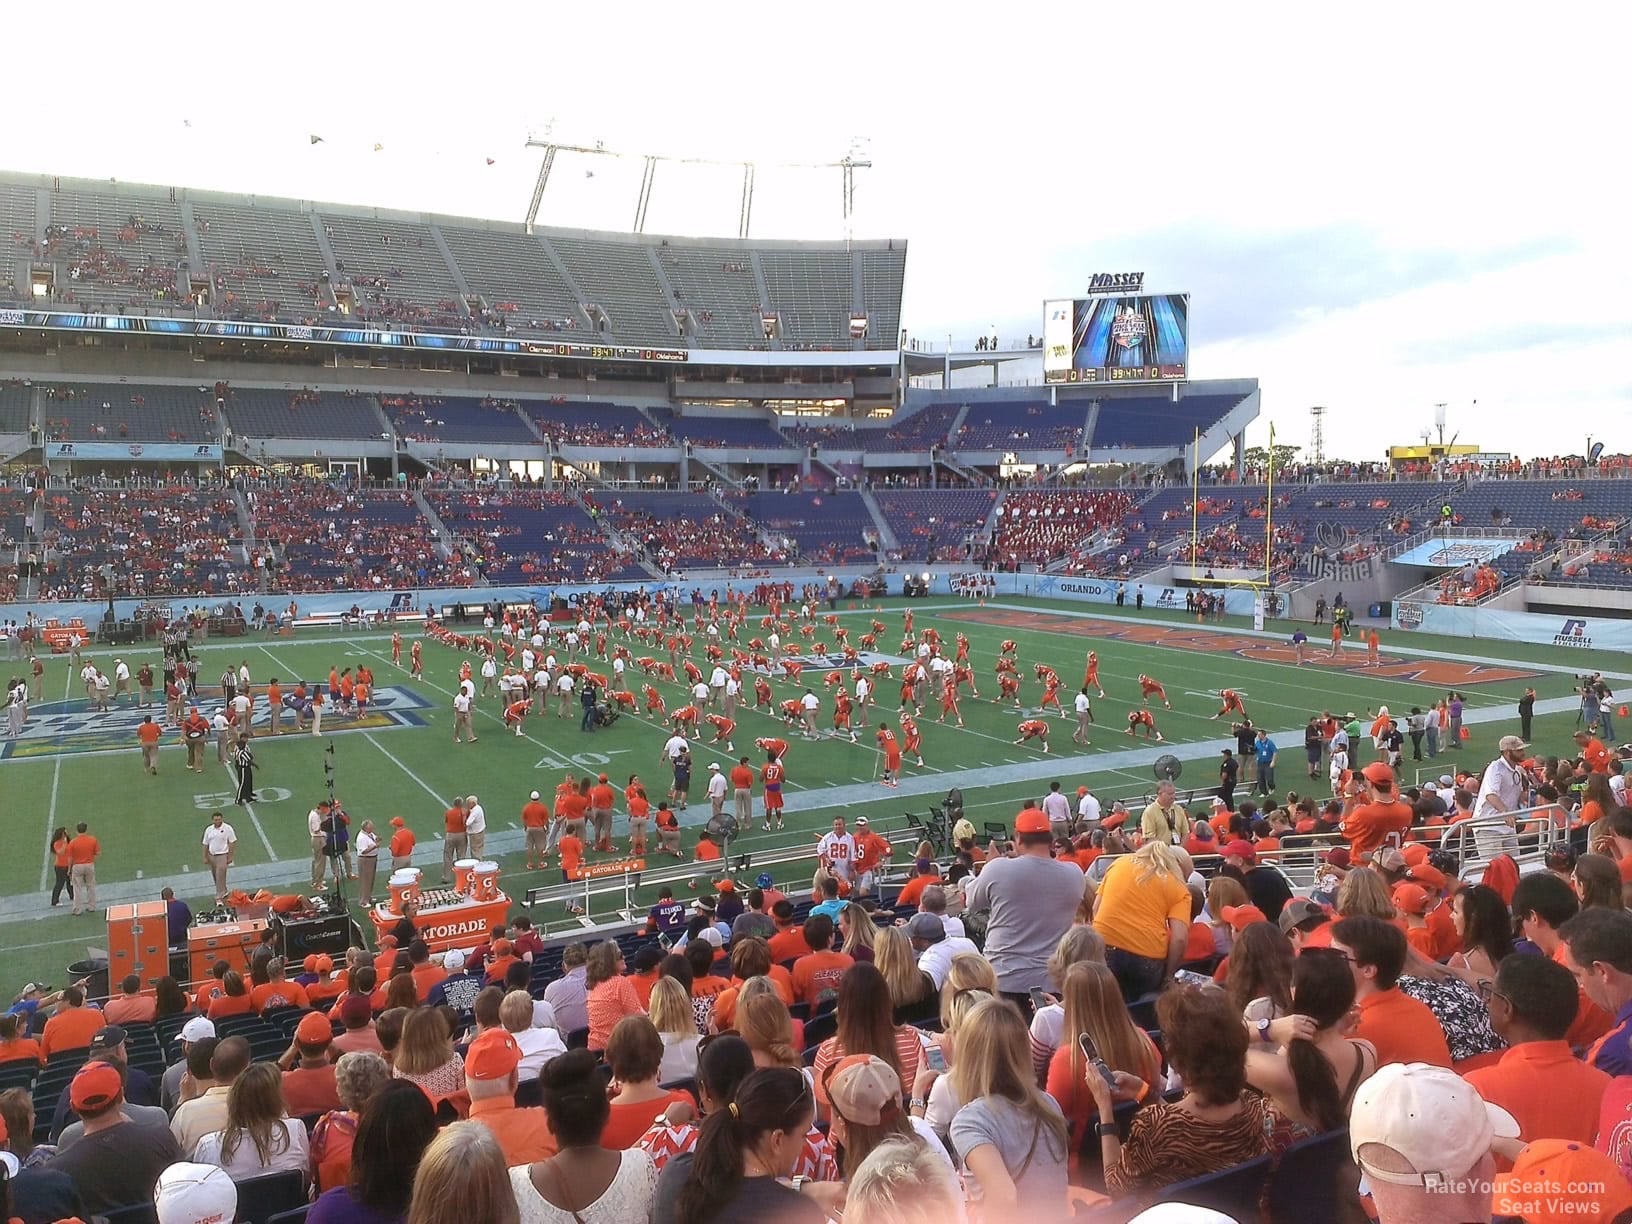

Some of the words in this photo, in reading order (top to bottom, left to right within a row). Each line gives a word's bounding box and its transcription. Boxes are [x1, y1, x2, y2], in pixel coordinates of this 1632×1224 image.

[1089, 272, 1144, 287] MASSEY
[1299, 551, 1370, 581] Allstate
[1060, 583, 1102, 596] ORLANDO
[1554, 634, 1593, 644] RUSSELL
[534, 752, 610, 770] 40
[767, 768, 779, 779] 87
[193, 787, 292, 809] 50
[830, 842, 849, 859] 28
[592, 864, 624, 874] GATORADE
[483, 877, 492, 888] G
[401, 890, 411, 900] G
